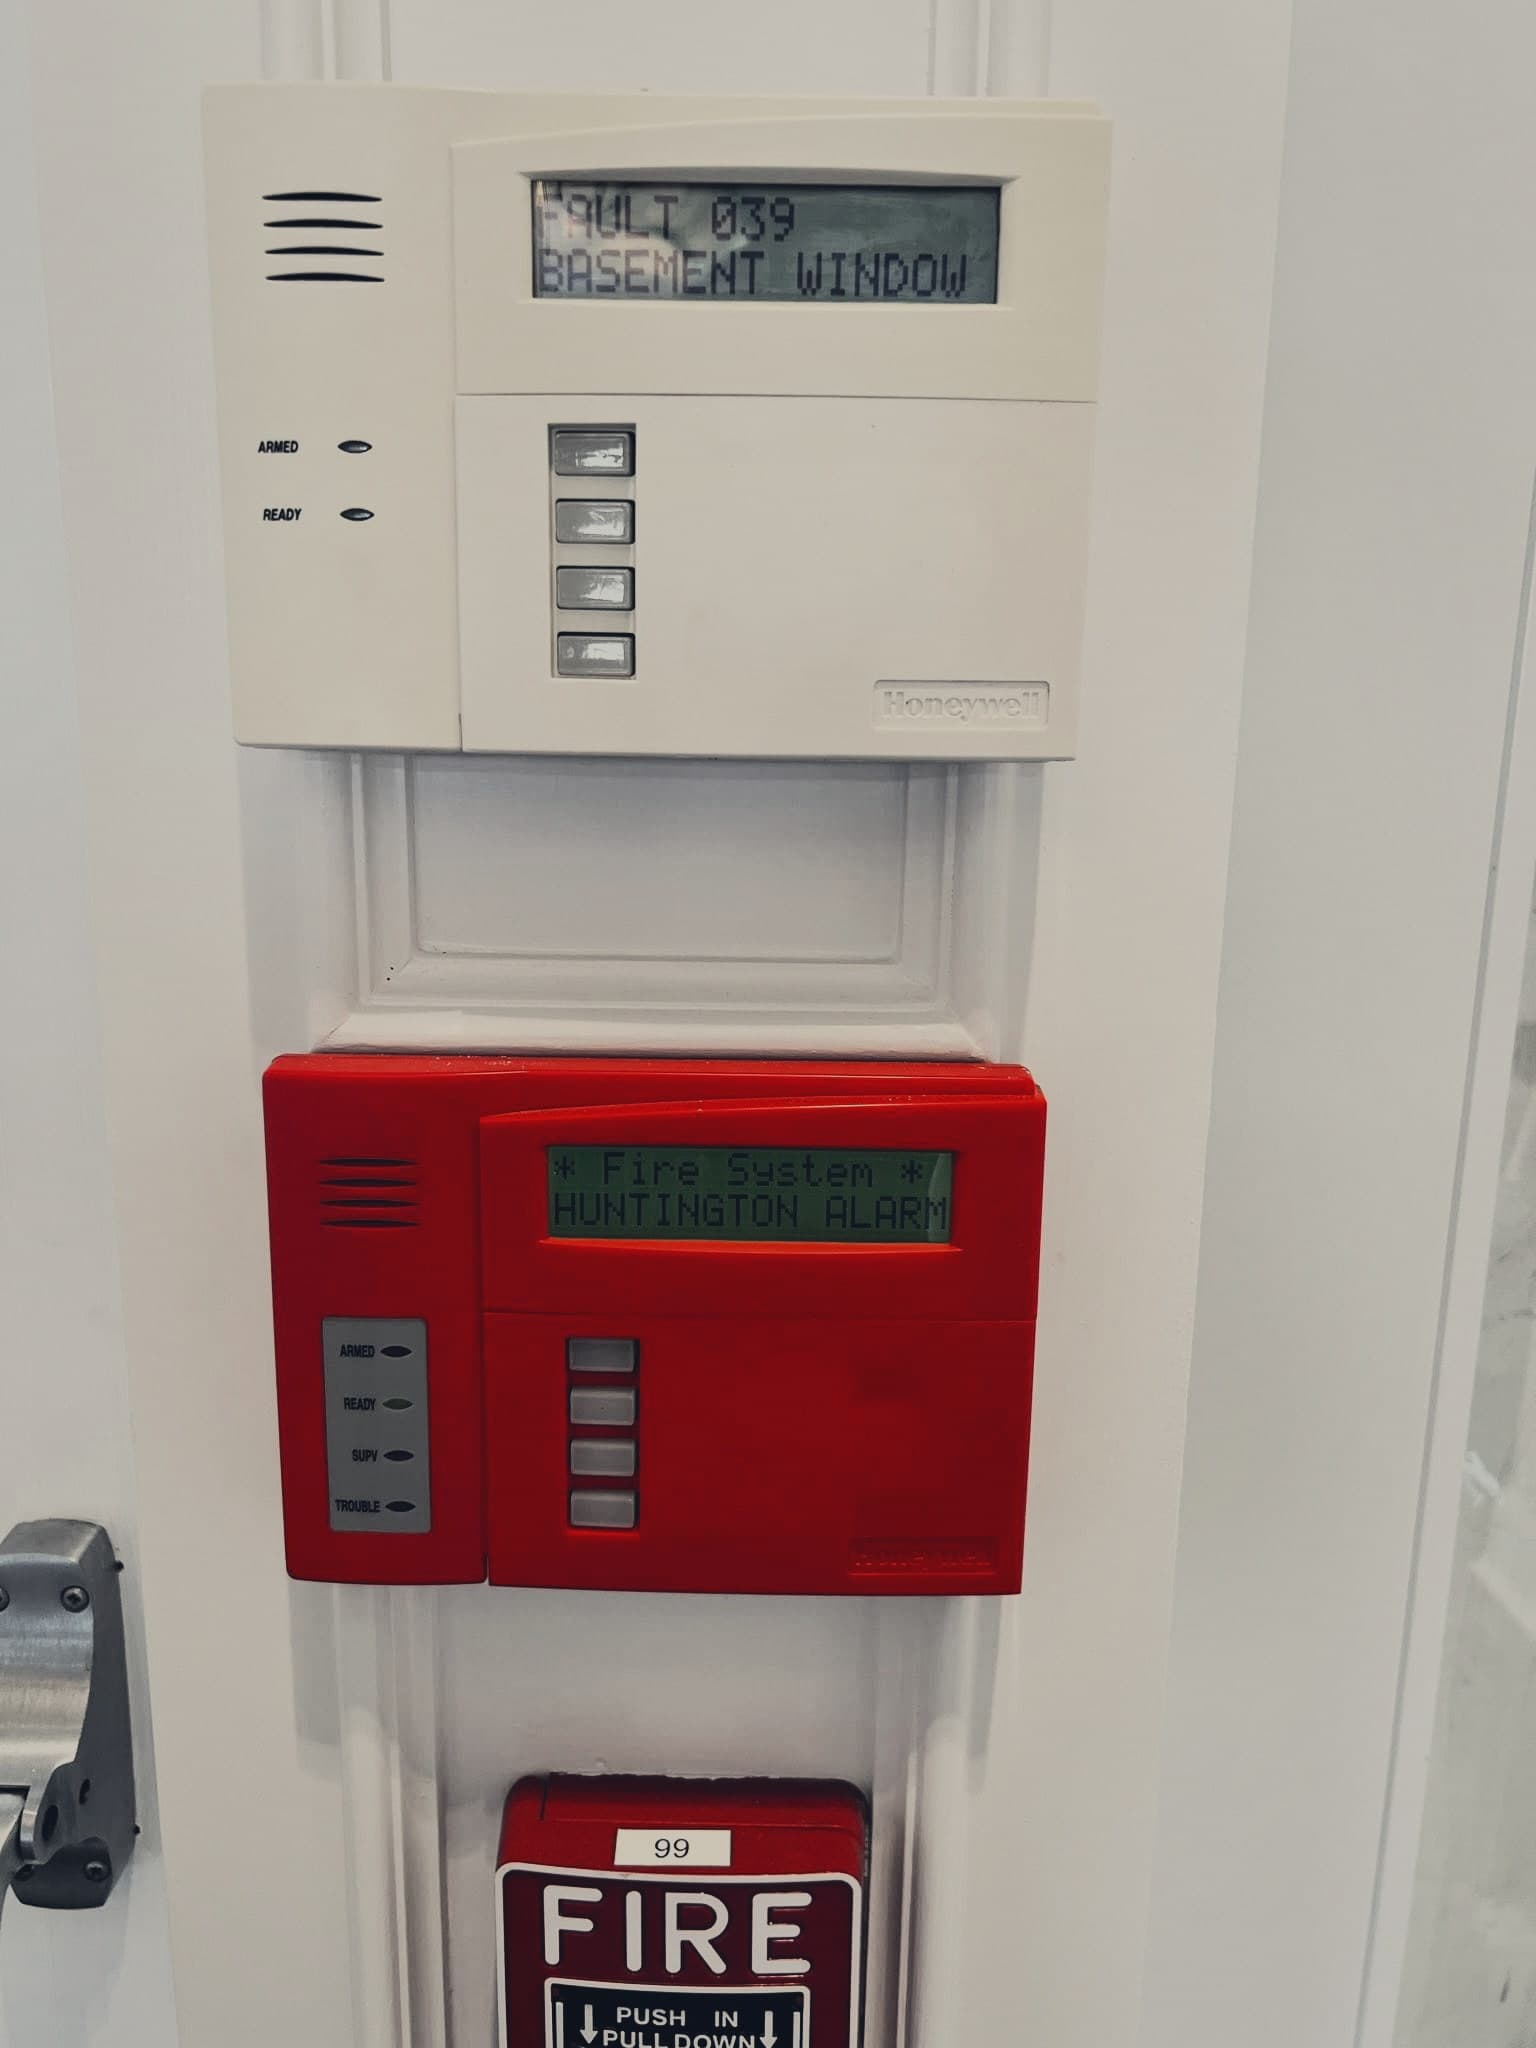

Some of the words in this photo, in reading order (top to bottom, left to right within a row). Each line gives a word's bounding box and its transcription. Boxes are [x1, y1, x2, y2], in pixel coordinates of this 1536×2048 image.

[711, 197, 795, 241] 039
[538, 248, 764, 295] BASEMENT
[799, 252, 967, 297] WINDOW
[258, 440, 299, 454] ARMED
[263, 508, 302, 521] READY
[882, 690, 1041, 726] Honeywell
[603, 1151, 699, 1186] Fire
[728, 1153, 872, 1188] System
[554, 1192, 798, 1228] HUNTINGTON
[825, 1196, 946, 1231] ALARM
[339, 1344, 376, 1358] ARMED
[343, 1397, 376, 1411] READY
[352, 1449, 378, 1462] SUPV
[335, 1499, 380, 1513] TROUBLE
[653, 1838, 690, 1858] 99
[543, 1884, 813, 1974] FIRE
[616, 2006, 686, 2027] PUSH
[714, 2011, 738, 2028] IN
[602, 2028, 674, 2048] PULL
[675, 2033, 756, 2048] DOWN
